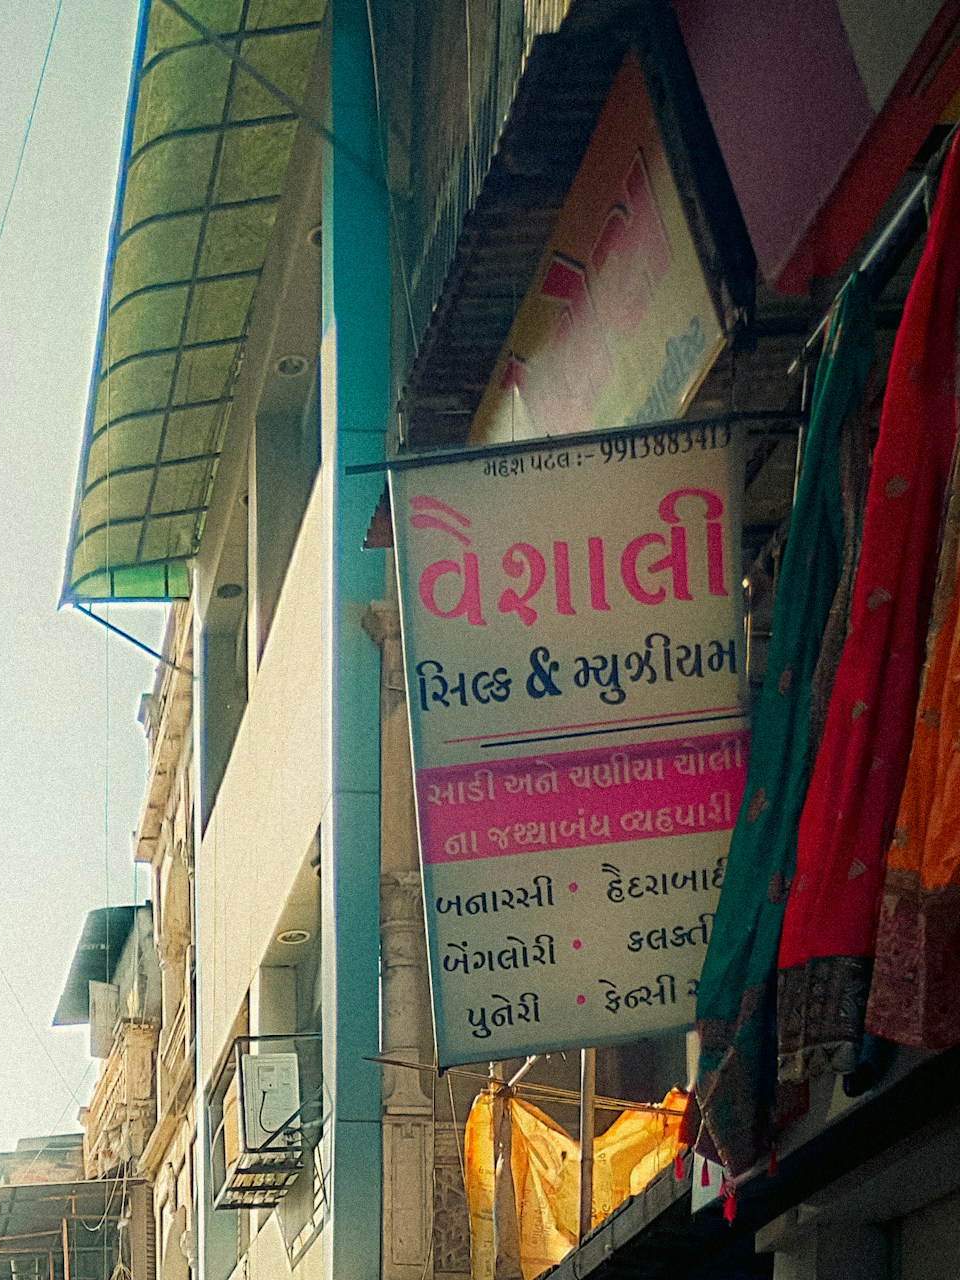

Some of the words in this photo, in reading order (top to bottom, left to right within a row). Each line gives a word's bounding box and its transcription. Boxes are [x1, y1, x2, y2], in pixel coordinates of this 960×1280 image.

[410, 488, 729, 627] વૈશાલી
[415, 660, 512, 711] સિલ્ક
[526, 646, 562, 700] &
[427, 768, 495, 806] સાડી
[503, 760, 559, 796] અને
[569, 753, 664, 789] ચણીયા
[445, 831, 477, 855] ના
[436, 875, 555, 918] બનારસી
[601, 857, 727, 902] હૈદરાબાદ
[467, 993, 540, 1039] પુનેરી
